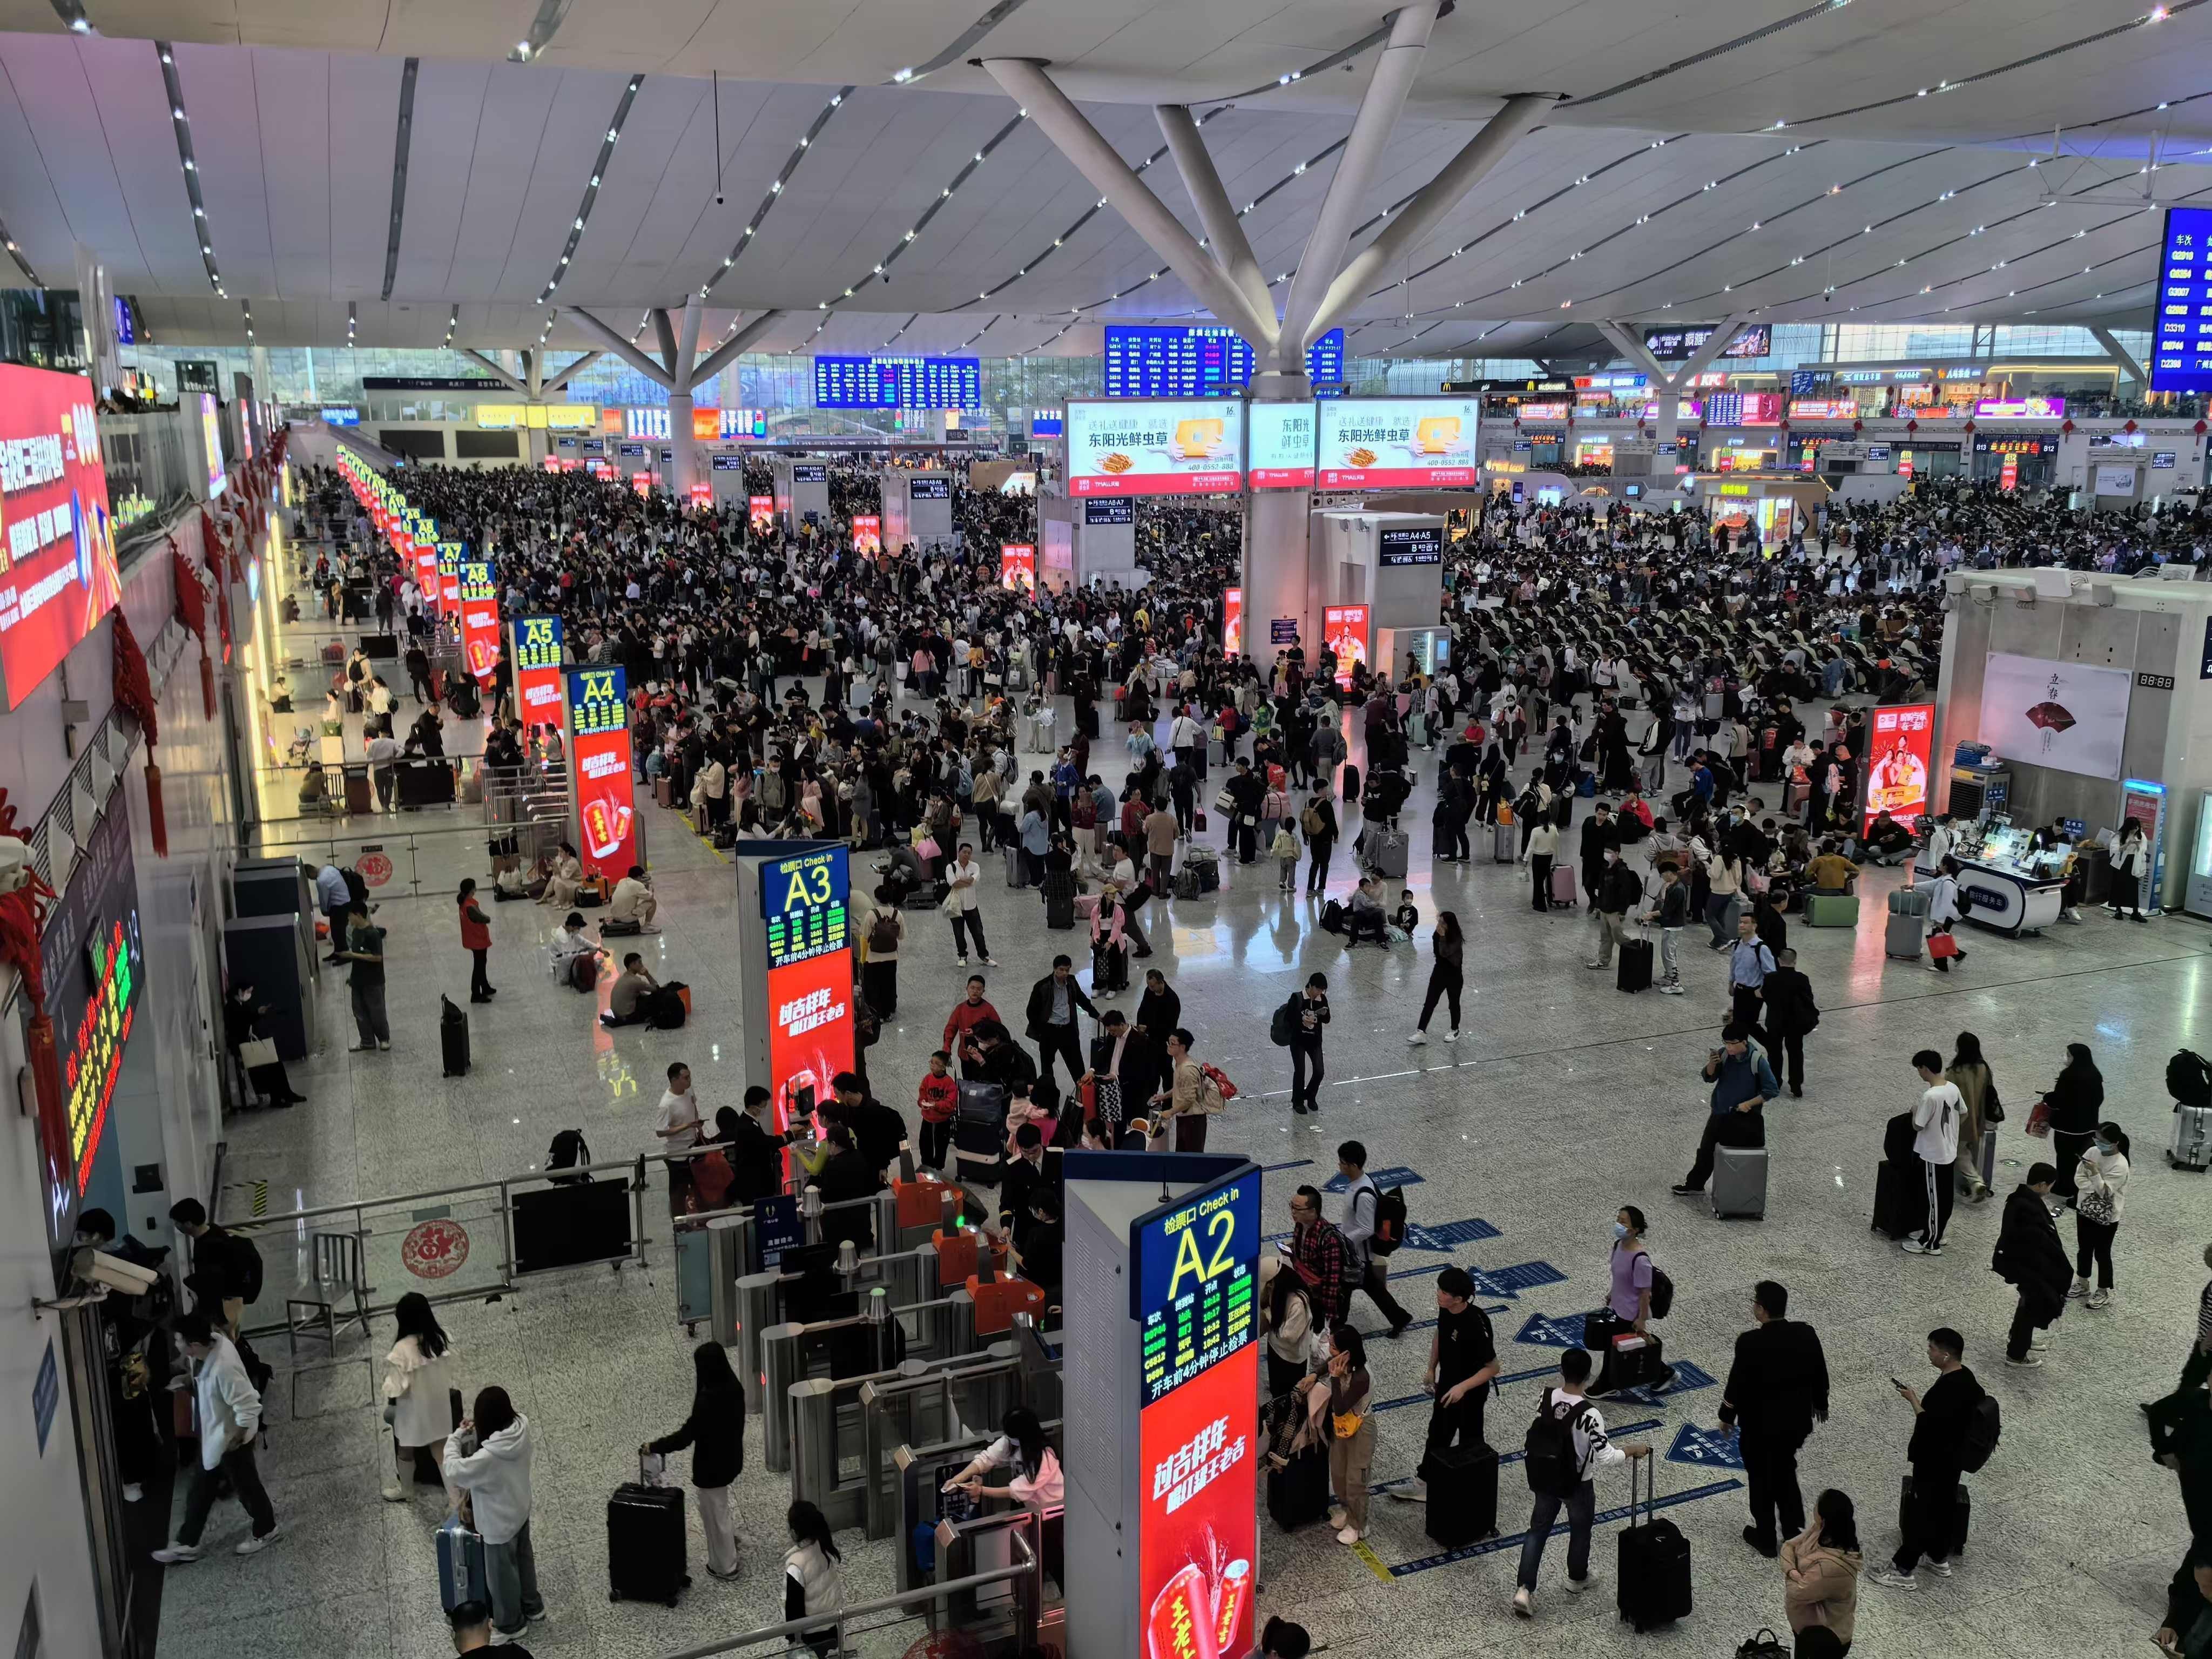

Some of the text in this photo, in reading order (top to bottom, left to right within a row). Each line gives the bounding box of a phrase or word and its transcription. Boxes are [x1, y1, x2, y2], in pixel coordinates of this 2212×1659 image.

[1539, 383, 1566, 391] McDonald's
[1701, 374, 1722, 386] KFC
[1282, 418, 1309, 432] 东阳光
[1338, 428, 1410, 442] 东阳光鲜虫草
[1089, 431, 1168, 447] 东阳光鲜虫草
[1282, 434, 1309, 449] 鲜虫草
[419, 521, 434, 534] A8
[444, 544, 462, 562] A7
[1412, 544, 1417, 552] B
[467, 566, 488, 583] A6
[527, 623, 553, 645] A5
[584, 676, 615, 704] A4
[2049, 672, 2059, 700] 立春
[805, 855, 825, 867] Check
[826, 853, 833, 862] in
[784, 865, 831, 912] A3
[775, 939, 843, 967] 开车前4分钟停止检票
[779, 987, 832, 1027] 过吉祥年
[1164, 1187, 1239, 1236] 检票口 Check in
[1168, 1209, 1235, 1301] A2
[1148, 1264, 1246, 1325] 车次 终到站 开点 状态
[1203, 1293, 1220, 1309] 18:12
[1178, 1322, 1191, 1338] 厦门
[1203, 1306, 1220, 1323] 18:17
[1203, 1320, 1220, 1337] 18:32
[1203, 1333, 1220, 1350] 18:42
[1151, 1328, 1247, 1399] 开车前4分钟停止检票
[1152, 1415, 1230, 1501] 过吉祥年
[1166, 1434, 1247, 1515] 喝红罐王老吉
[1219, 1593, 1236, 1644] 王老吉
